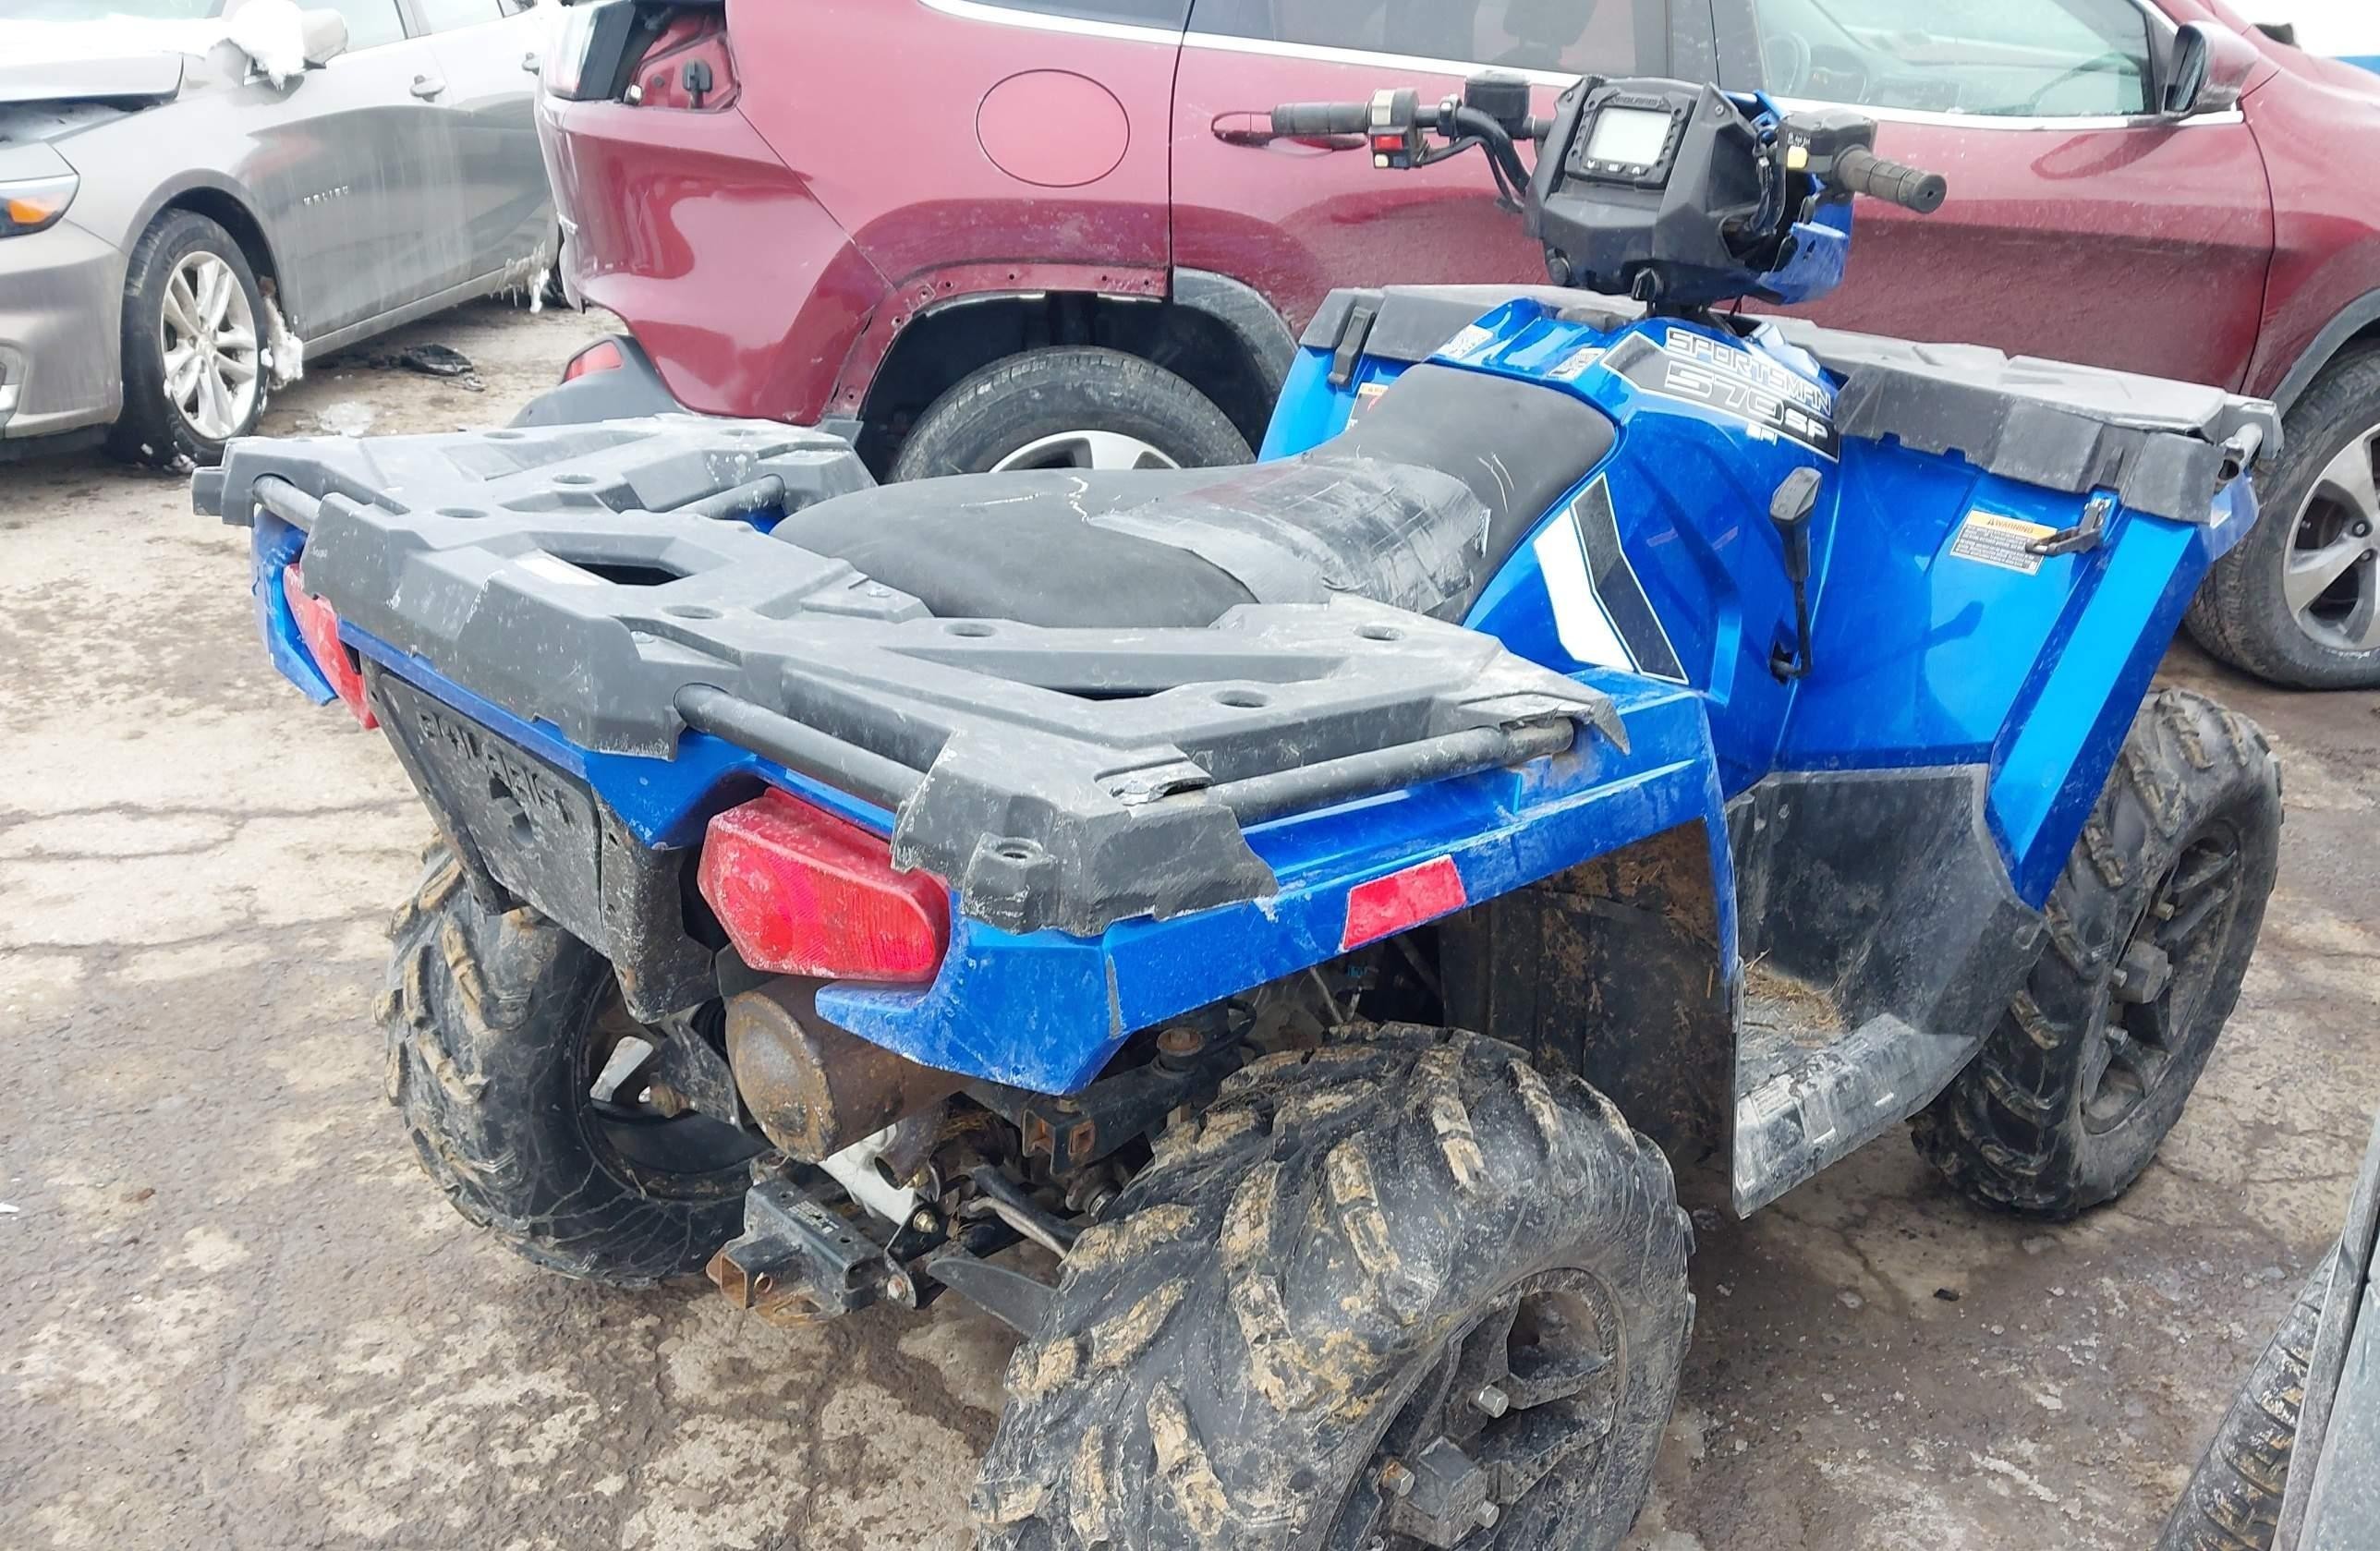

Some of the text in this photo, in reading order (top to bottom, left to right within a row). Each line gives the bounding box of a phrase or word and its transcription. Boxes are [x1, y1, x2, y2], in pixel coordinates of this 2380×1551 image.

[1665, 326, 1831, 417] SPORTSMAN
[1665, 359, 1828, 439] 570 SP
